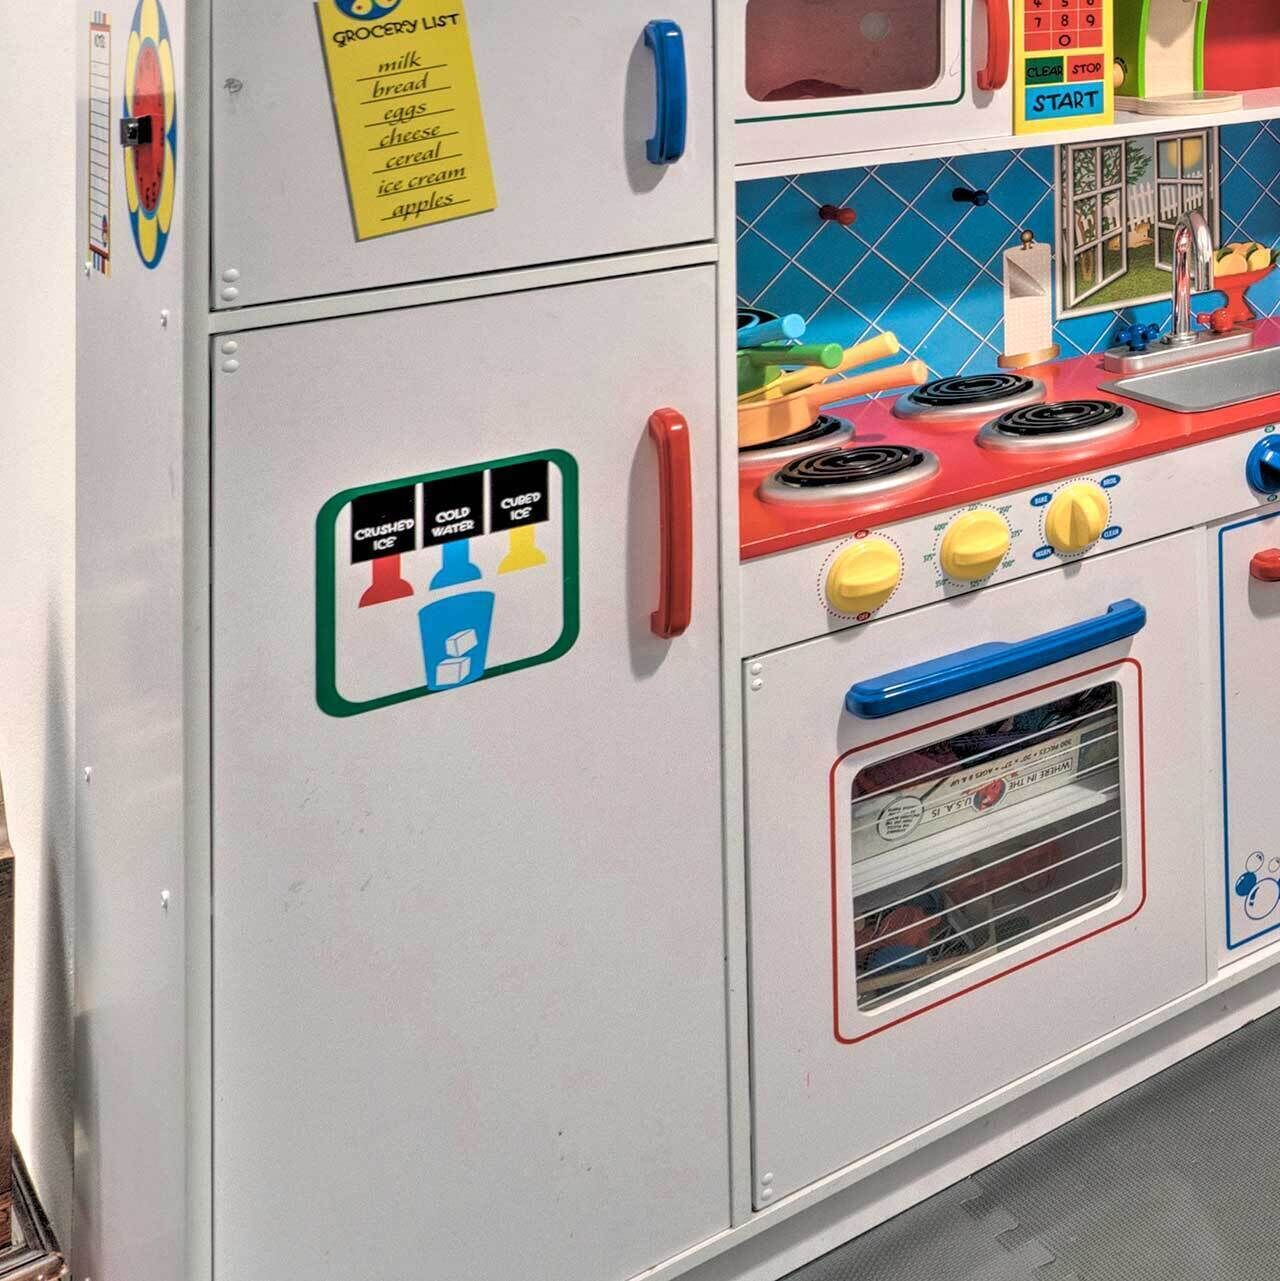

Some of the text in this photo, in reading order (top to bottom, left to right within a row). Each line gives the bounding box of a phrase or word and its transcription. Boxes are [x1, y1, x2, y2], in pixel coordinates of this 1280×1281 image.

[1034, 14, 1095, 28] 7 8 9
[333, 14, 460, 47] GROCERY LIST
[1059, 35, 1070, 46] 0
[378, 51, 422, 73] milk
[1072, 62, 1101, 75] STOP
[1026, 66, 1063, 78] CLEAR
[373, 72, 428, 98] bread
[1033, 91, 1099, 112] START
[384, 102, 427, 125] eggs
[380, 125, 440, 148] cheese
[386, 142, 441, 168] cereal
[378, 168, 466, 194] ice cream
[392, 192, 454, 220] apples
[501, 492, 541, 508] CUBED
[436, 507, 470, 524] COLD
[510, 506, 532, 520] ICE
[354, 519, 414, 540] CRUSHED
[431, 520, 474, 538] WATER
[1104, 529, 1119, 538] CLEAN
[373, 536, 397, 550] ICE
[1039, 743, 1060, 755] PIECES
[976, 767, 994, 778] AGES
[1040, 761, 1071, 775] WHERE
[1008, 779, 1025, 791] THE
[1027, 774, 1038, 784] IN
[944, 797, 972, 812] U.S.A.
[932, 808, 941, 818] IS
